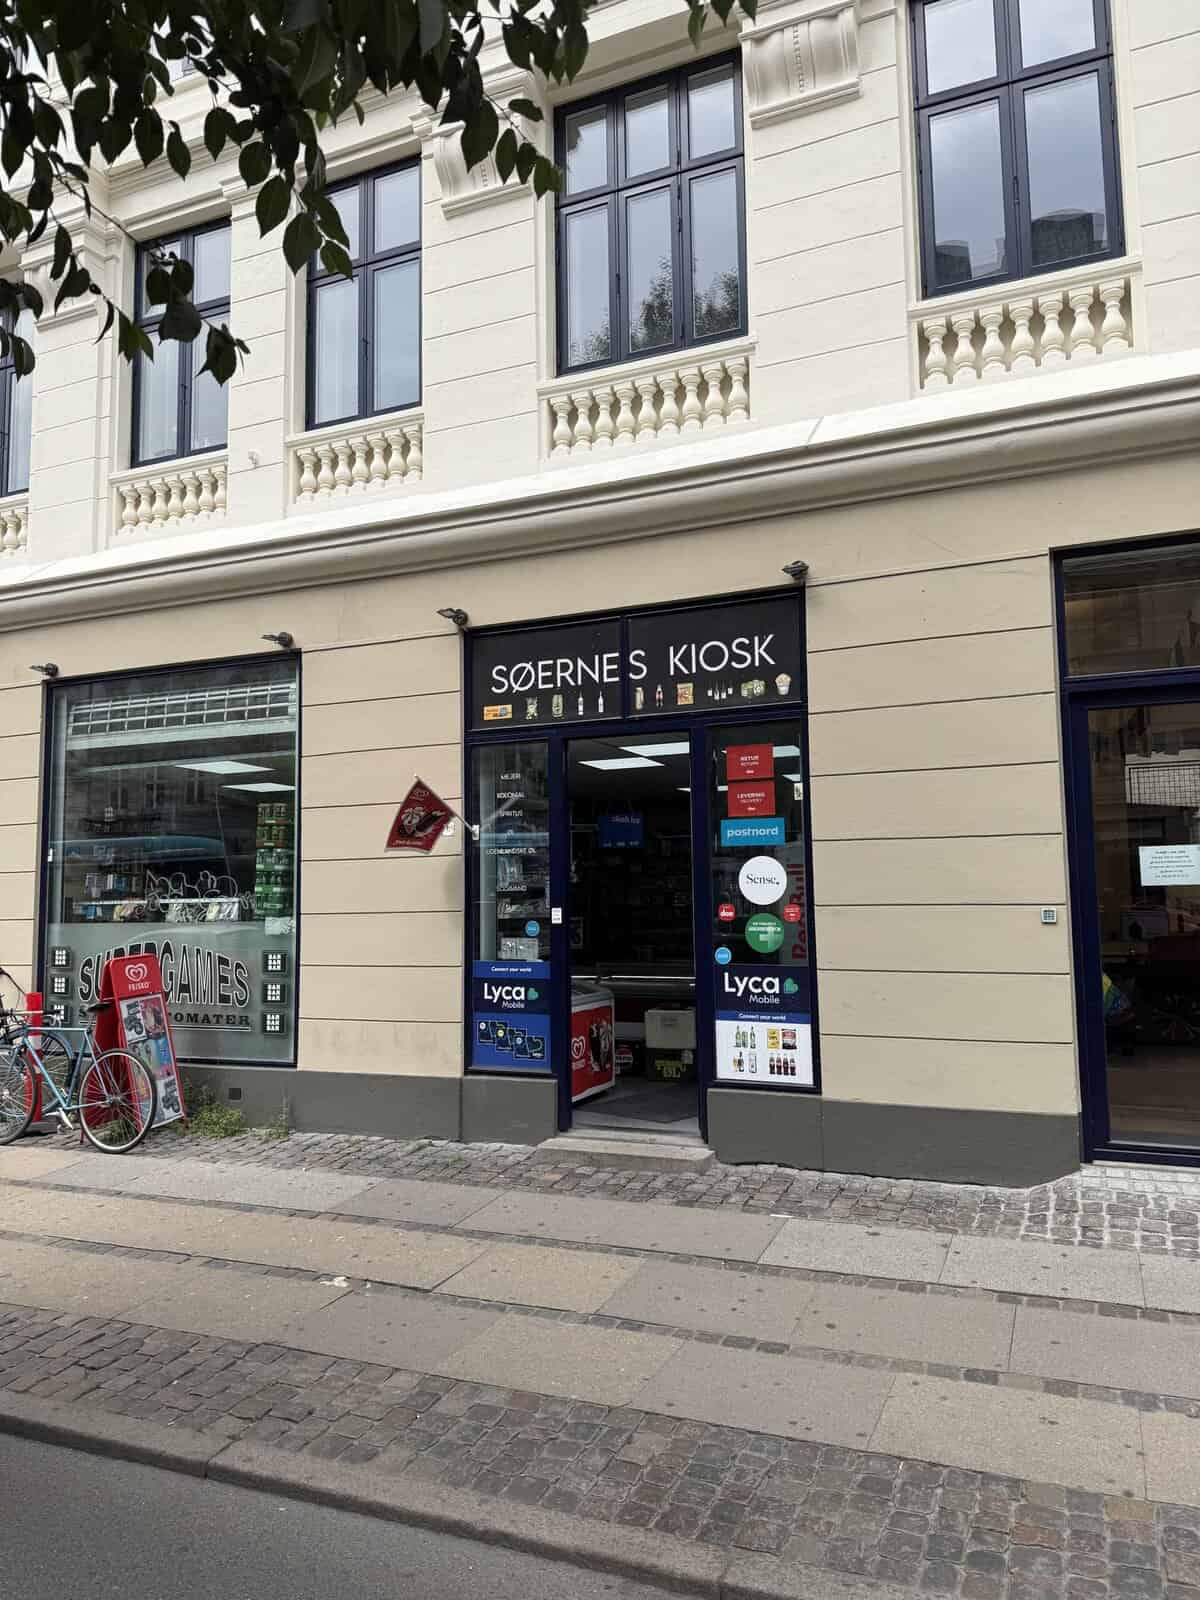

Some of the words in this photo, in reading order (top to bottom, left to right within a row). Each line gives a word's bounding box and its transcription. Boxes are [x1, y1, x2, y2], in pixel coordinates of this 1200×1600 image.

[491, 649, 648, 694] SØERNES
[669, 633, 777, 676] KIOSK
[727, 826, 779, 839] postnord
[483, 982, 525, 1003] Lyca
[724, 972, 780, 997] Lyca
[501, 1001, 525, 1009] Mobile
[748, 994, 780, 1004] Mobile
